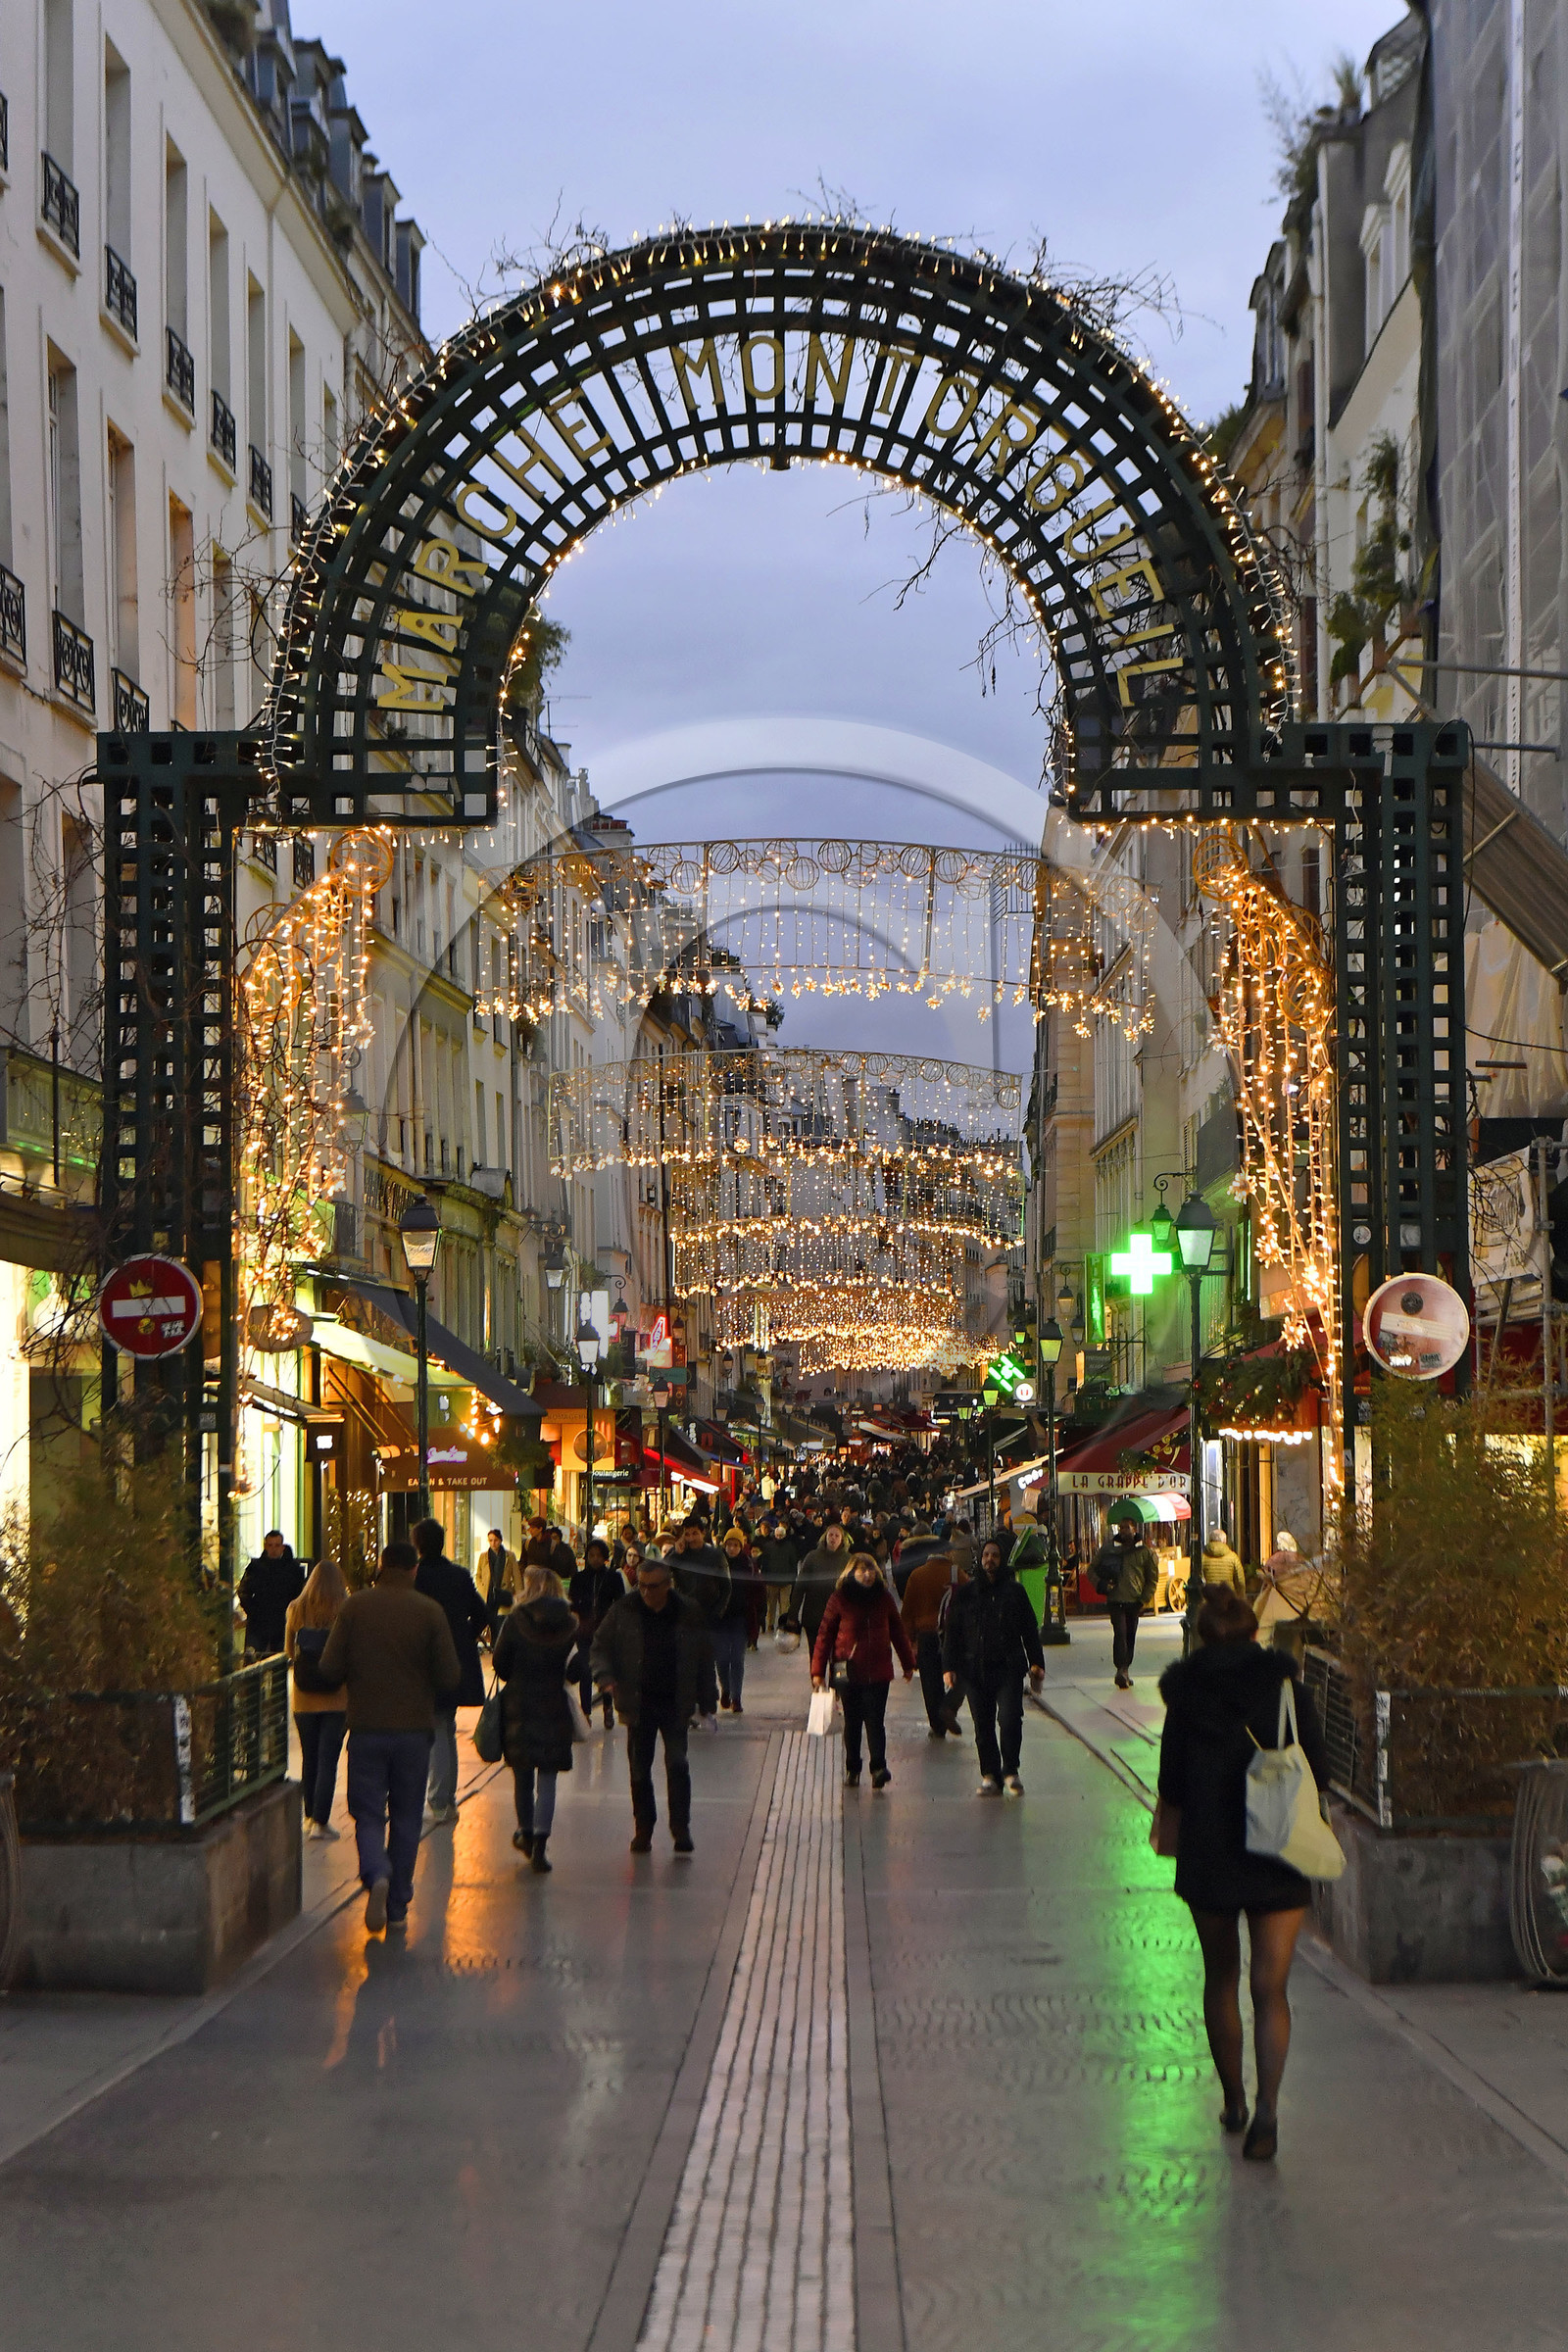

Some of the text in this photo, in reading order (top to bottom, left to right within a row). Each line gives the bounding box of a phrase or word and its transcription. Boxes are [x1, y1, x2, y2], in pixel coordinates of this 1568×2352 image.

[670, 332, 1184, 708] MONTORGUEIL
[408, 1478, 421, 1487] EA
[447, 1477, 468, 1486] TAKE
[470, 1477, 488, 1486] OUT
[1072, 1474, 1186, 1489] LA GRAPPE D'OR
